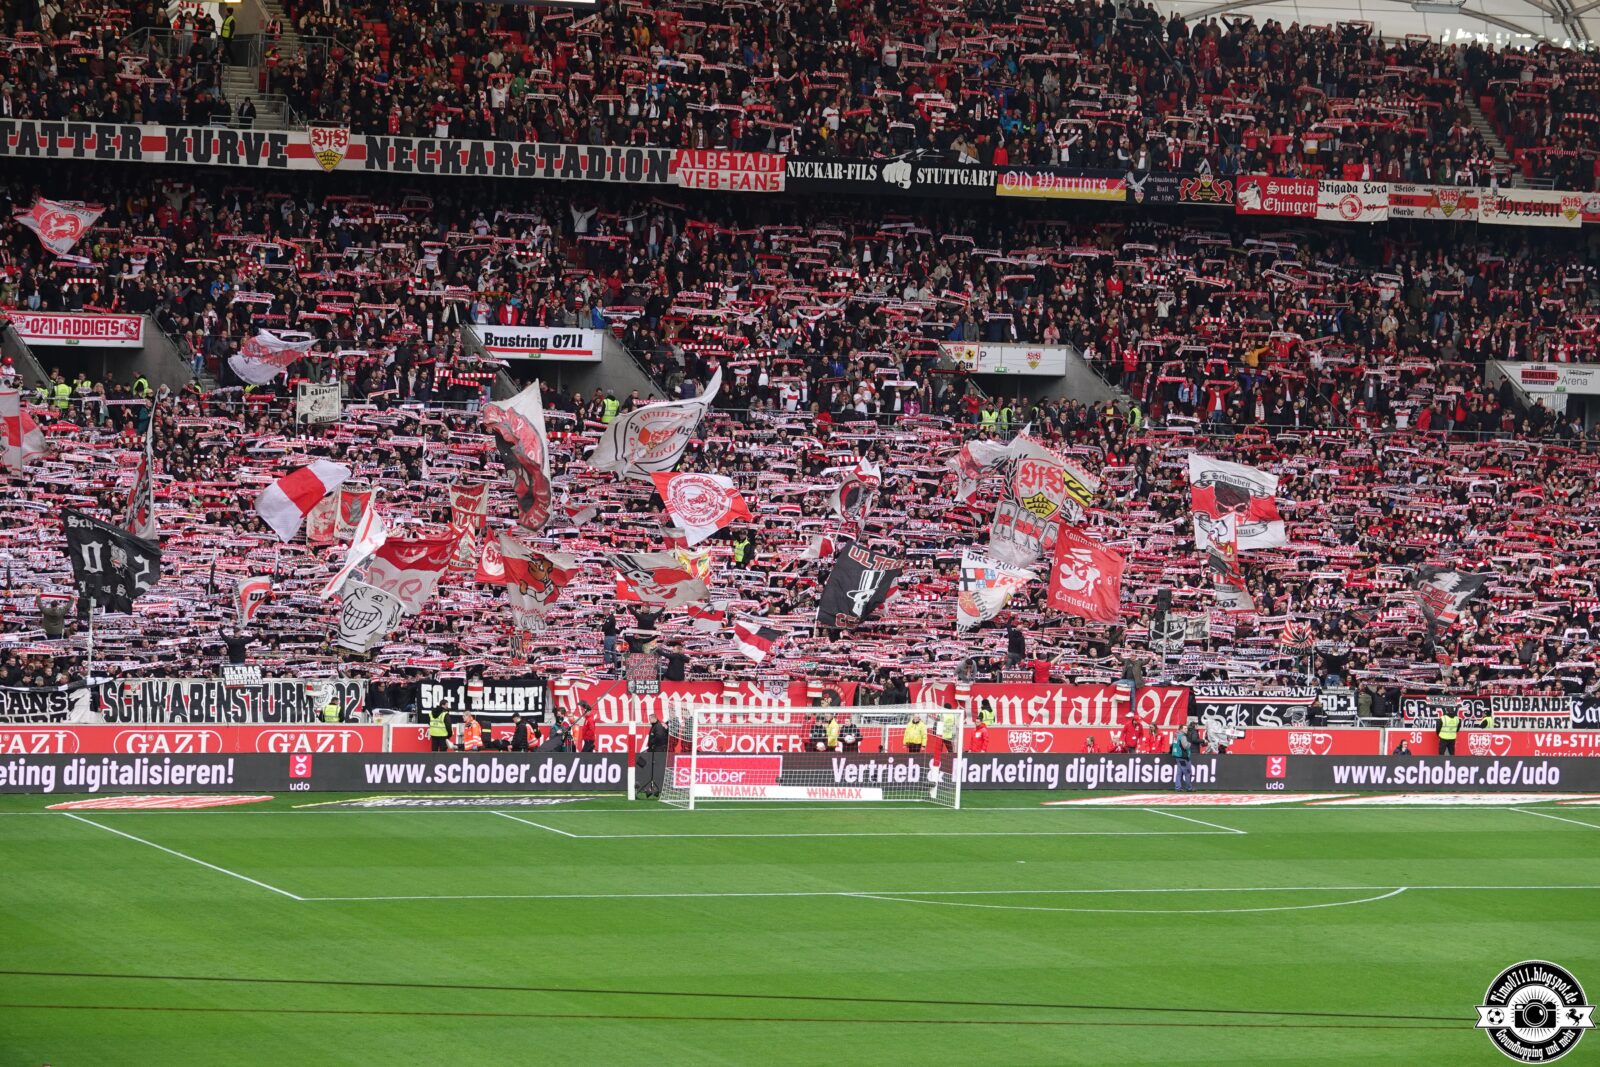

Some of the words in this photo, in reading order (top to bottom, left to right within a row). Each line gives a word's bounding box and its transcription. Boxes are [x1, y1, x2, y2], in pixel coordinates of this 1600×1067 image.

[165, 126, 288, 168] KURVE
[366, 135, 671, 183] NECKARSTADION
[680, 151, 785, 171] ALBSTADT
[786, 160, 878, 182] NECKAR-FILS
[916, 167, 998, 187] STUTTGART
[1003, 171, 1036, 190] Old
[1037, 172, 1108, 194] Warriors
[1266, 181, 1314, 197] Suebia
[1317, 181, 1358, 195] Brigada
[1363, 182, 1387, 194] Loca
[1263, 198, 1317, 214] Ehingen
[1495, 195, 1561, 220] Hessen
[30, 318, 58, 335] 0711
[62, 318, 120, 336] ADDICTS
[484, 332, 548, 350] Brustring
[552, 334, 583, 348] 0711
[1561, 376, 1588, 386] Arena
[223, 666, 261, 675] ULTRAS
[421, 682, 465, 712] 50+1
[472, 687, 543, 710] BLEIBT!
[1193, 686, 1261, 696] SCHWABEN
[0, 691, 68, 715] ANS
[103, 682, 315, 723] SCHWABENSTURM
[1138, 689, 1184, 727] 97
[1319, 695, 1357, 710] 50+1
[1463, 699, 1485, 718] 36
[1493, 695, 1570, 711] SÜDBANDE
[1571, 700, 1600, 723] Ca
[1494, 717, 1570, 729] STUTTGART
[727, 734, 803, 753] JOKER
[1410, 731, 1422, 744] 36
[63, 758, 235, 792] digitalisieren!
[365, 757, 622, 785] www.schober.de/udo
[679, 767, 746, 783] Schober
[832, 757, 921, 783] Vertrieb
[952, 758, 1060, 789] Marketing
[1333, 758, 1561, 785] www.schober.de/udo
[290, 781, 310, 791] udo
[711, 786, 766, 798] WINAMAX
[807, 787, 862, 799] WINAMAX
[1265, 781, 1285, 790] udo
